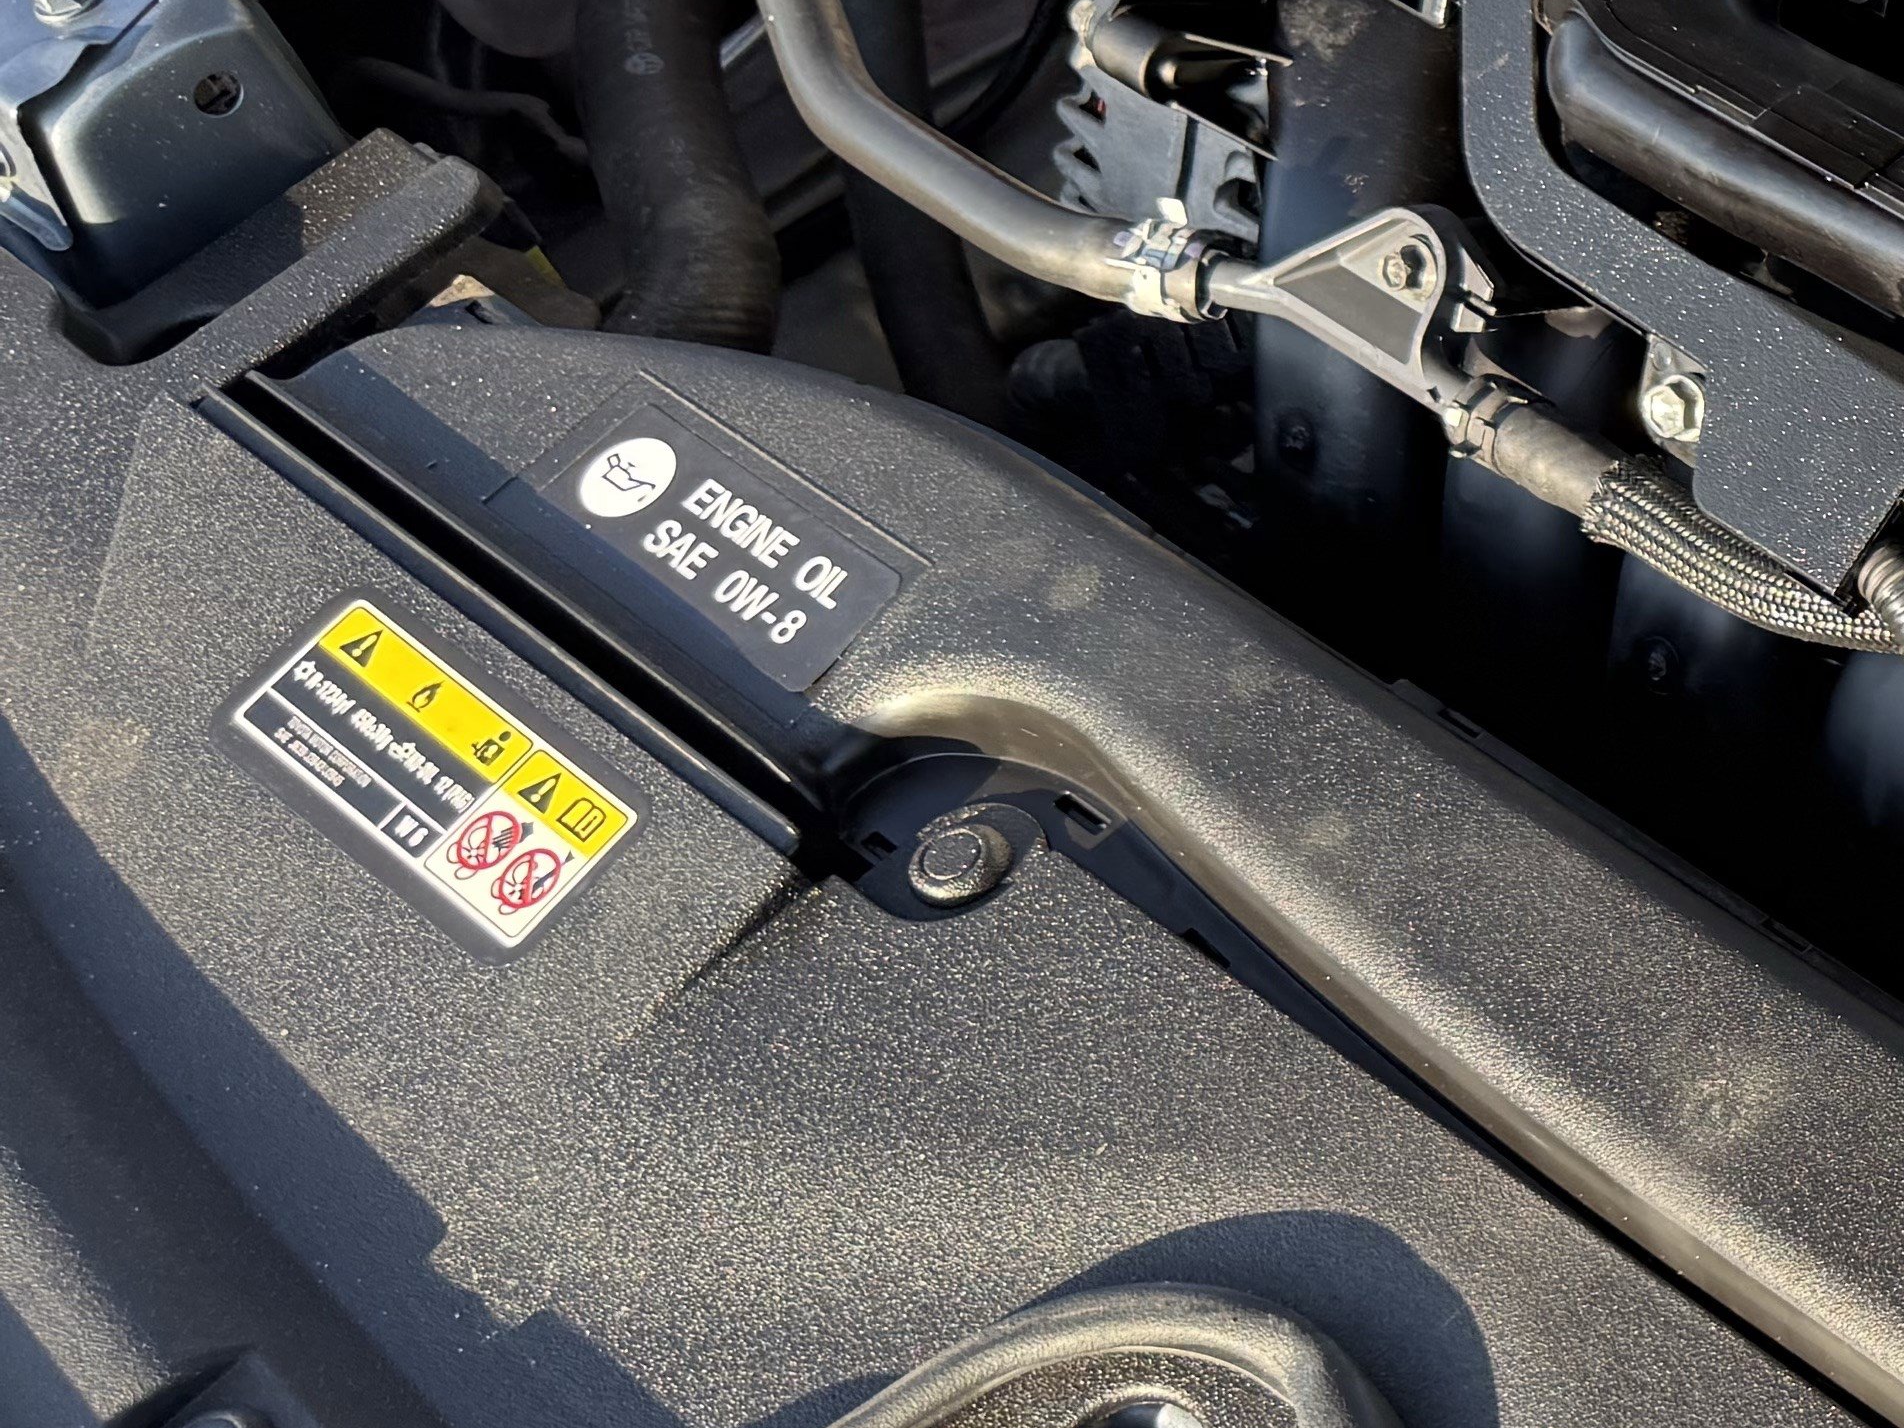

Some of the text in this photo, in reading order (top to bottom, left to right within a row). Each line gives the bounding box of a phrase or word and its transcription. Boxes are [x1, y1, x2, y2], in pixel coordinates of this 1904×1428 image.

[641, 520, 806, 644] SAE 0W-8
[680, 479, 848, 606] ENGINE OIL
